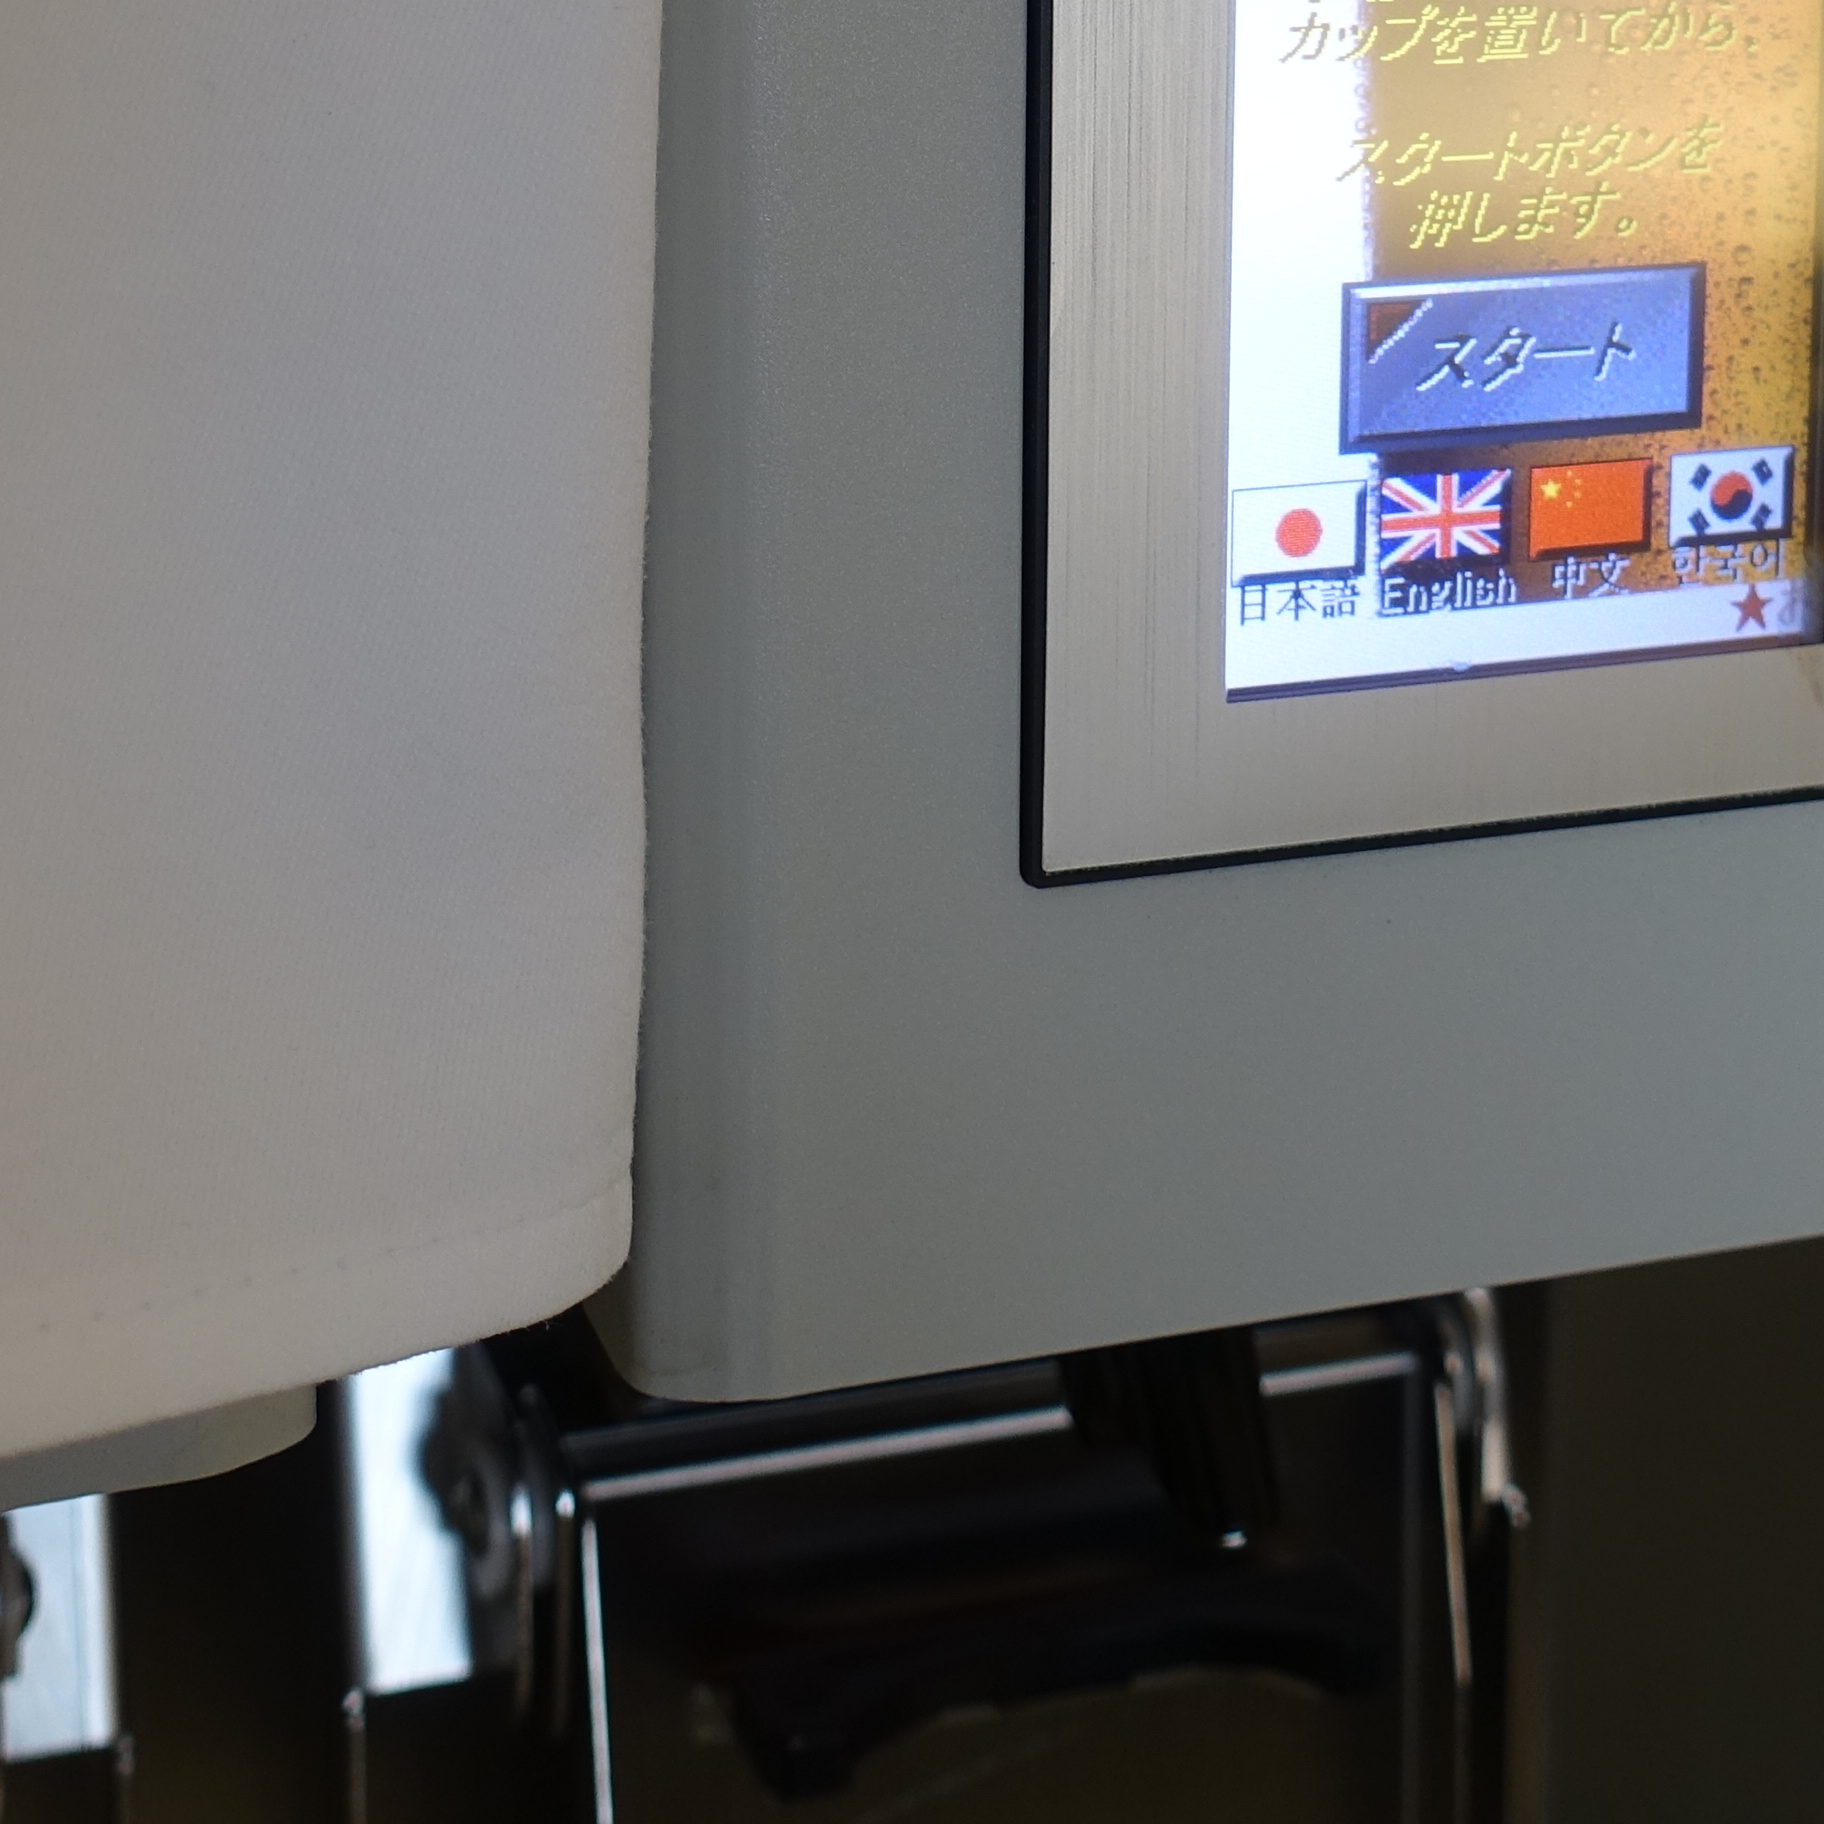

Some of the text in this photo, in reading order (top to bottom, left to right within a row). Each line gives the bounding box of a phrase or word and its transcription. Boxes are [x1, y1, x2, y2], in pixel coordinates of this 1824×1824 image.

[1336, 116, 1724, 186] スタートボタンを
[1415, 322, 1636, 391] スタート
[1381, 570, 1518, 616] English
[1552, 553, 1630, 598] 中文
[1238, 580, 1362, 626] 日本語
